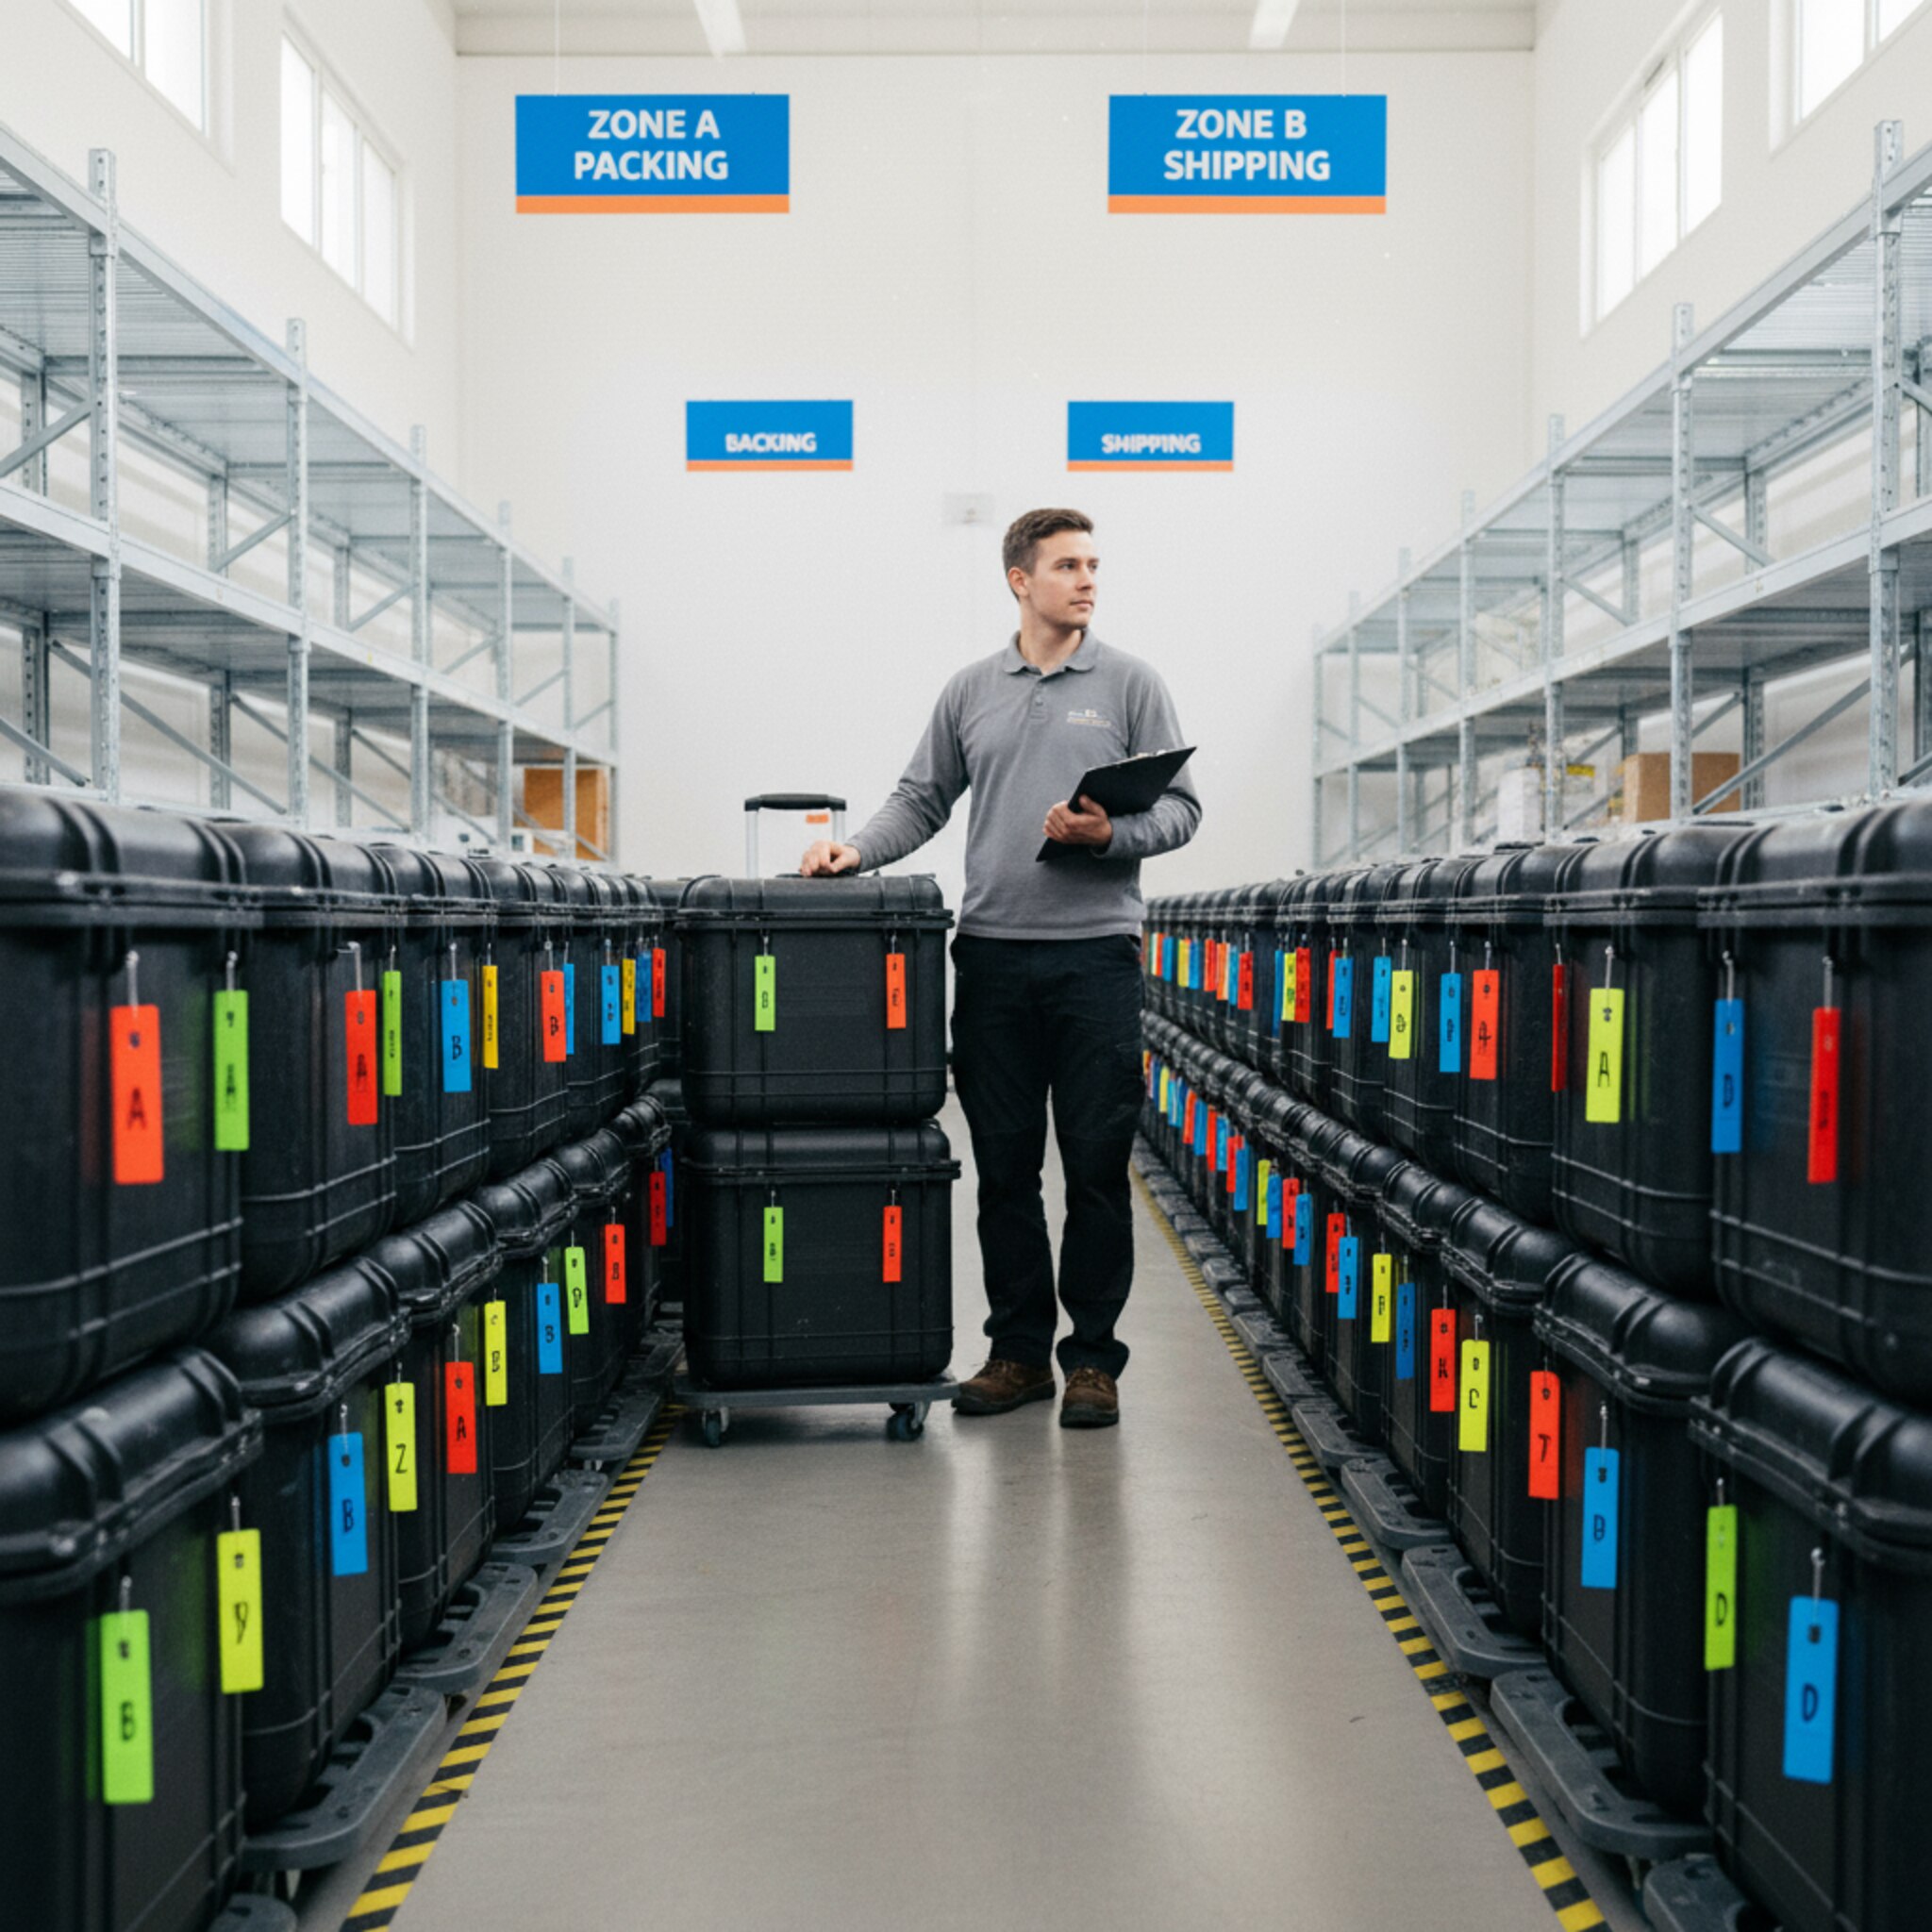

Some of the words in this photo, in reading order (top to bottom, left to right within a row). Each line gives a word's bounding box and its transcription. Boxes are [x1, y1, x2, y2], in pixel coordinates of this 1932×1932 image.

[589, 109, 685, 140] ZONE
[694, 110, 721, 139] A
[1175, 109, 1273, 139] ZONE
[1285, 109, 1307, 139] B
[575, 150, 728, 180] PACKING
[1163, 150, 1331, 181] SHIPPING
[1101, 433, 1202, 454] SHIPPING
[1597, 1050, 1611, 1088] A
[127, 1087, 146, 1130] A
[1468, 1388, 1480, 1410] C
[456, 1415, 468, 1442] A
[394, 1442, 408, 1475] Z
[341, 1498, 356, 1535] B
[1715, 1591, 1728, 1627] D
[1801, 1682, 1820, 1724] D
